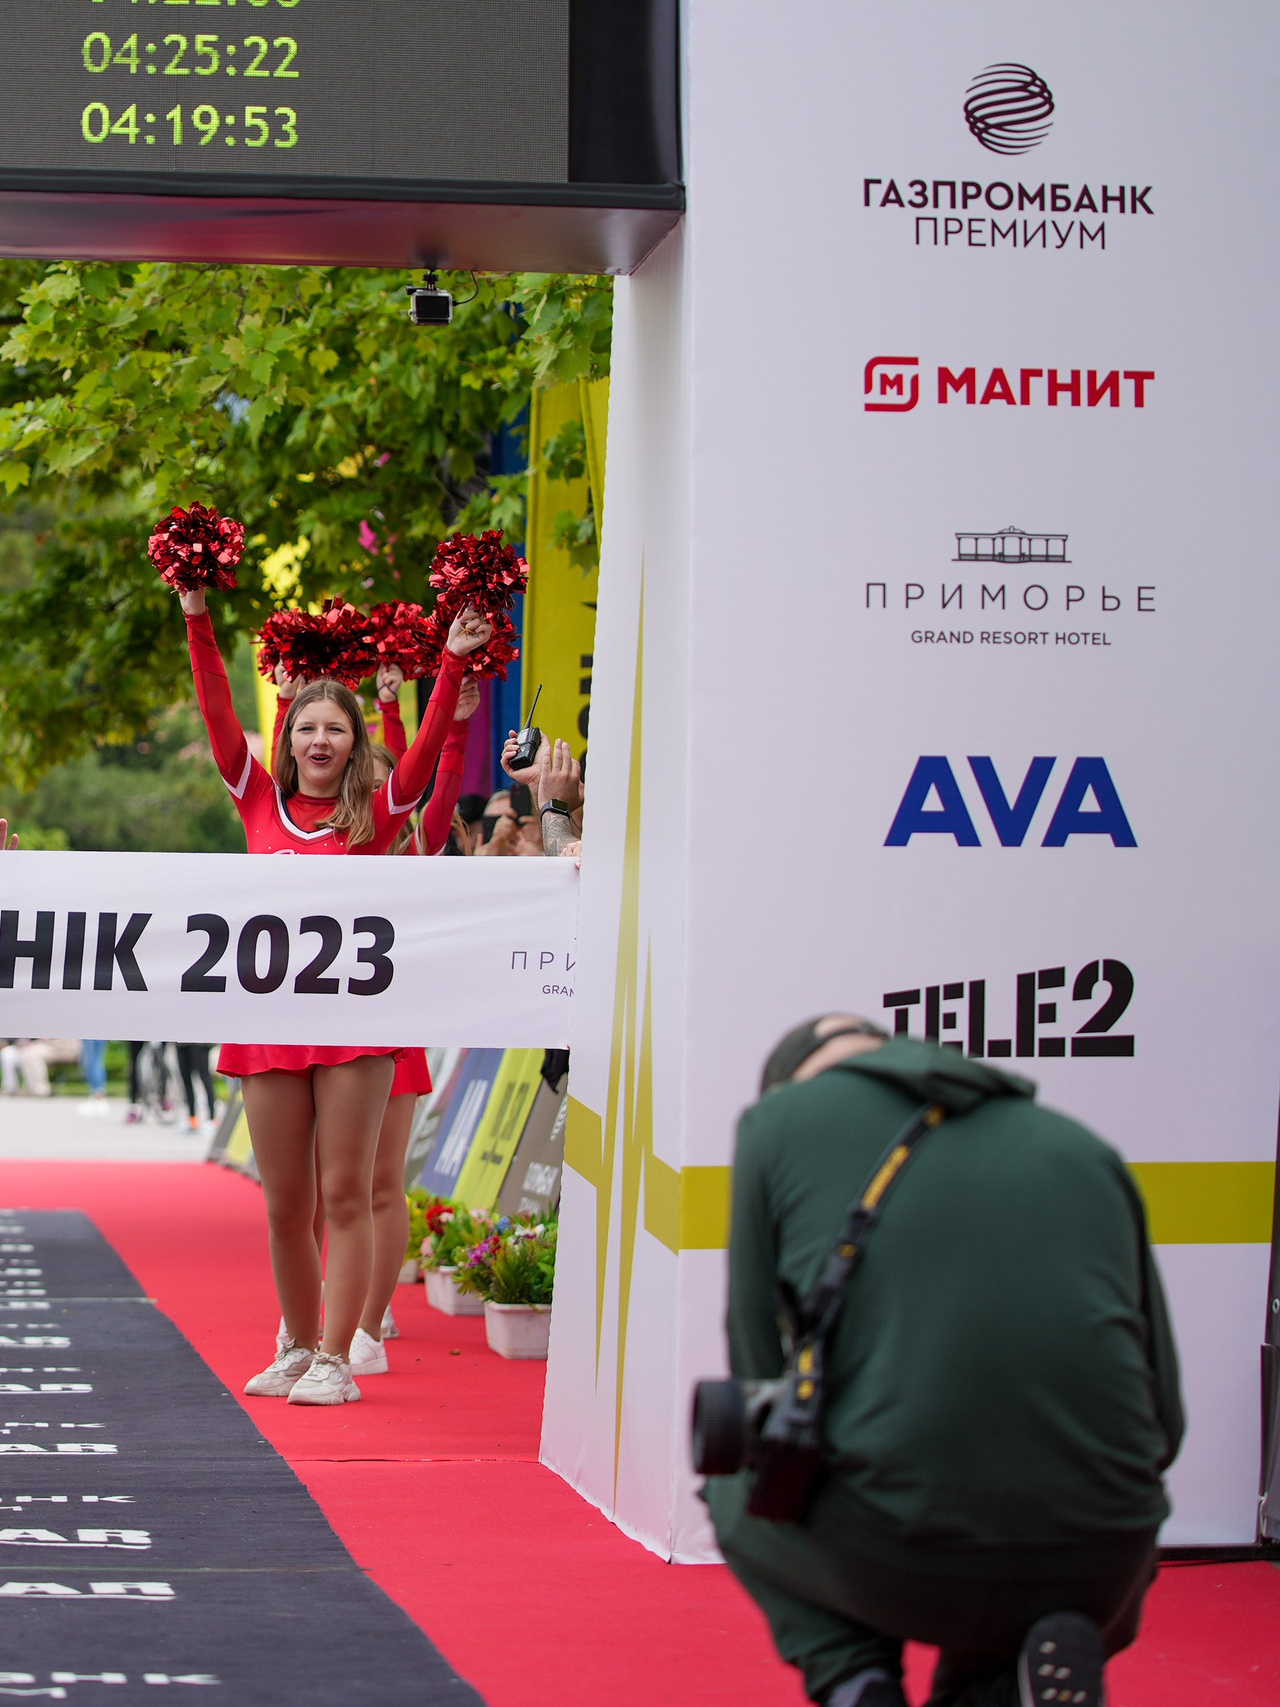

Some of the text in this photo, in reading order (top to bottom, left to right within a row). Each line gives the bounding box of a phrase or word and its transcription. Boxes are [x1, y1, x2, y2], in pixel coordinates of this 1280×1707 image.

[81, 31, 301, 78] 04:25:22
[80, 101, 300, 149] 04:19:53
[862, 177, 1156, 215] ГАЗПРОМБАНК
[914, 216, 1107, 250] ПРЕМИУМ
[936, 365, 1156, 408] МАГНИТ
[864, 582, 1157, 613] ПРИМОРЬЕ
[910, 629, 1112, 647] GRAND RESORT HOTEL
[882, 755, 1139, 849] AVA
[179, 912, 397, 996] 2023
[882, 957, 1136, 1059] TELE2
